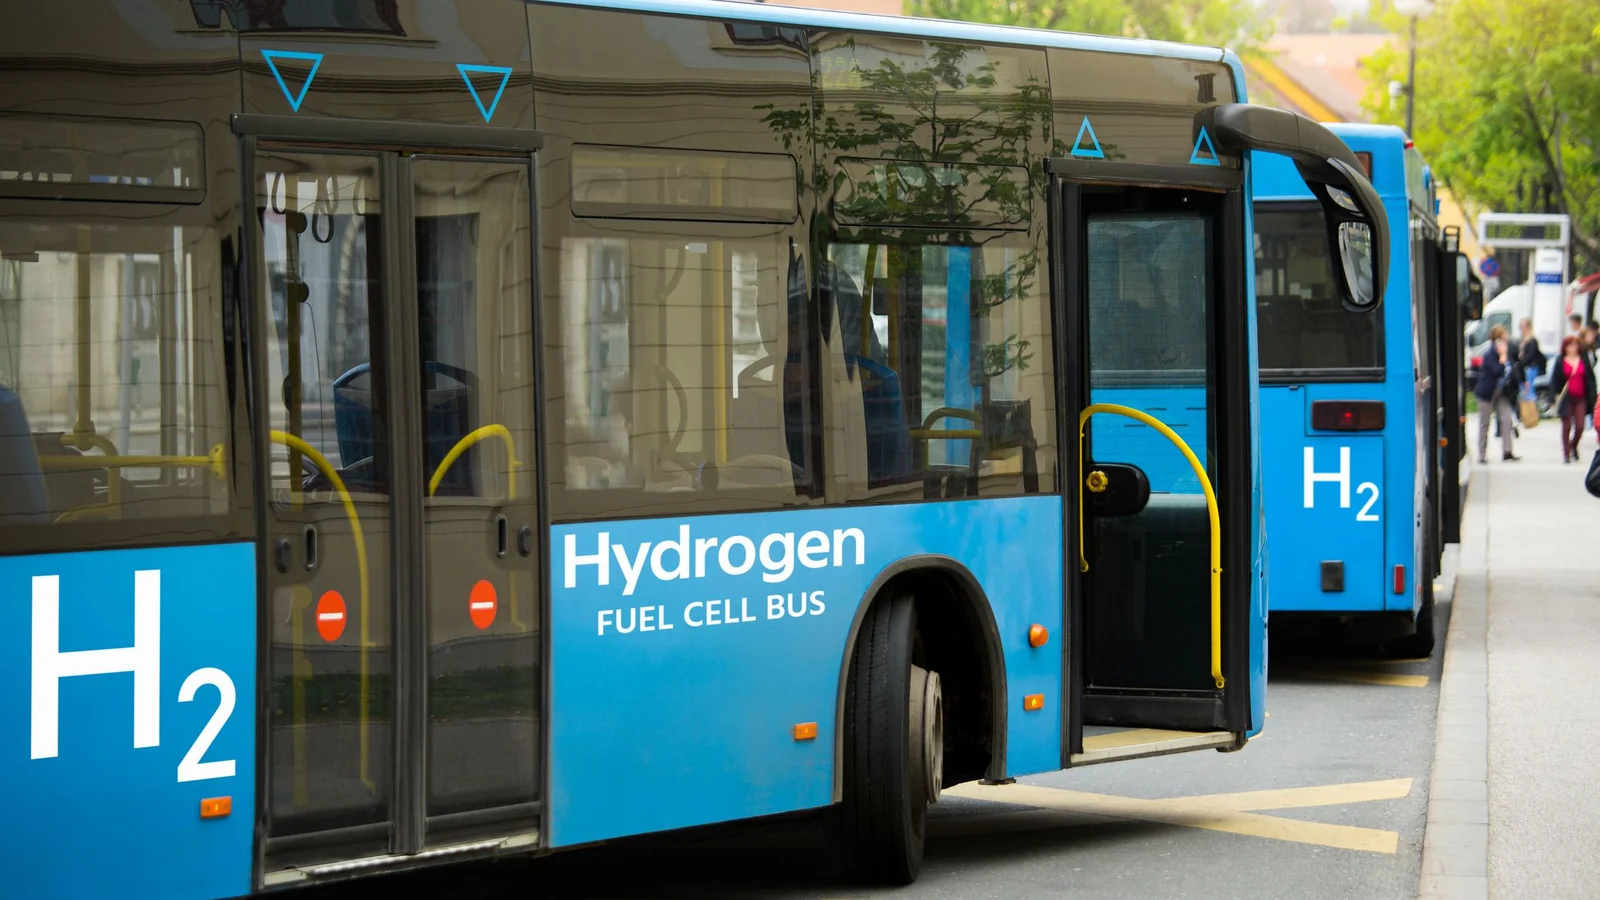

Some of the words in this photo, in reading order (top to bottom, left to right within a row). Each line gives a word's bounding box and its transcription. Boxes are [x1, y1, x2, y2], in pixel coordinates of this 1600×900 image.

[563, 524, 867, 596] Hydrogen
[597, 605, 674, 636] FUEL
[683, 597, 757, 627] CELL
[767, 590, 826, 621] BUS
